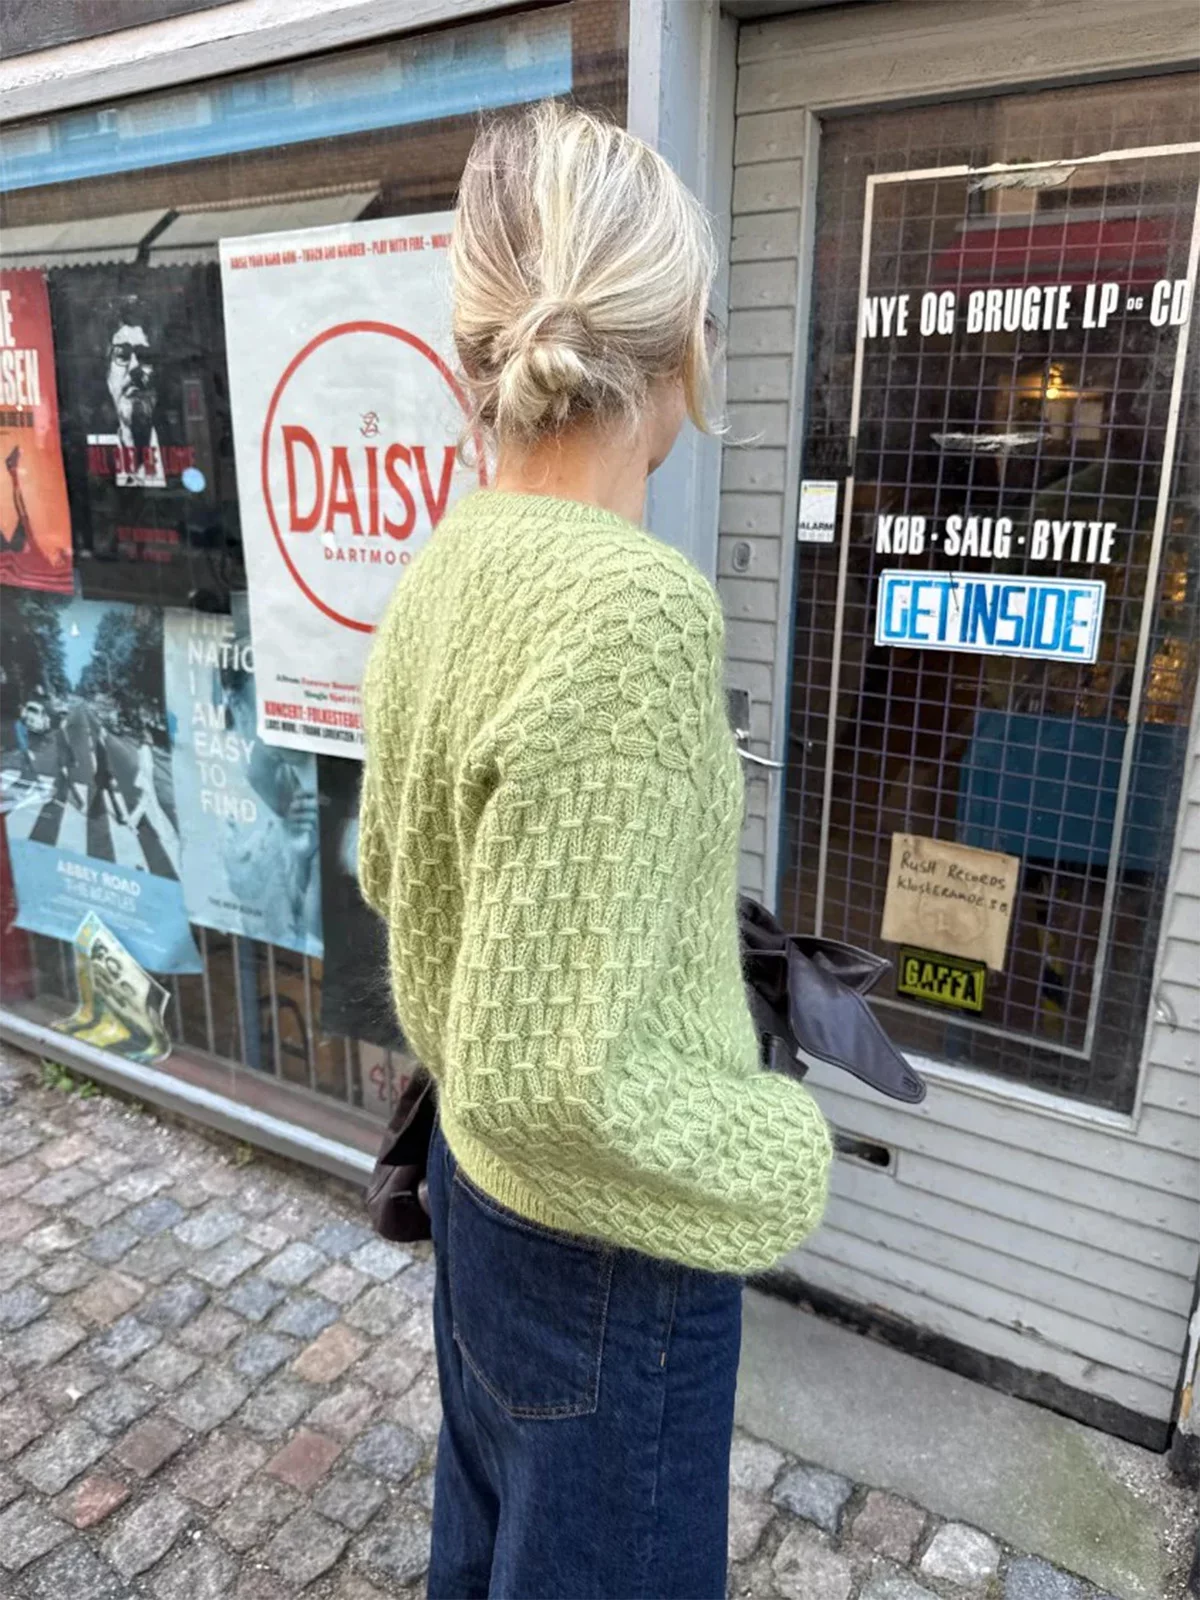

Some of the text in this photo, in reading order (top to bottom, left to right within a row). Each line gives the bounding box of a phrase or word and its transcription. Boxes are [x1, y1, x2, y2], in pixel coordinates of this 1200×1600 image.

[861, 294, 909, 339] NYE
[920, 291, 955, 336] OG
[966, 285, 1072, 333] BRUGTE
[1082, 283, 1120, 328] LP
[1149, 279, 1191, 327] CD
[799, 521, 834, 530] ALARM
[875, 514, 1118, 564] KØB SALG BYTTE
[192, 702, 226, 730] AM
[194, 730, 255, 764] EASY
[198, 761, 227, 789] TO
[200, 789, 258, 823] FIND
[101, 871, 141, 897] ROAD
[905, 958, 977, 1003] GAFFA
